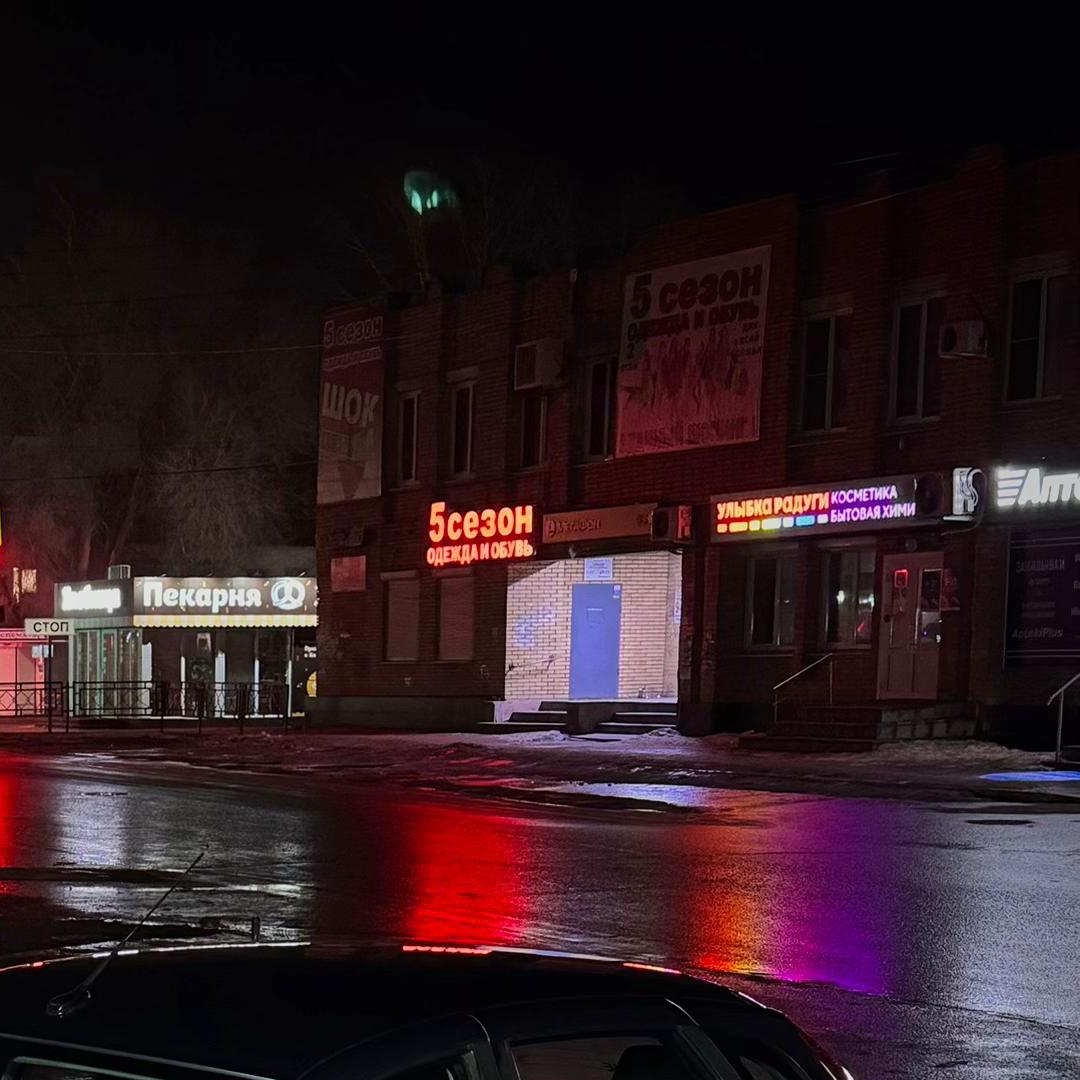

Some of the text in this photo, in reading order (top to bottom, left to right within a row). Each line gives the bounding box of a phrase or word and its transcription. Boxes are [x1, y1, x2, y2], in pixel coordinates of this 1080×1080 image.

[630, 264, 763, 319] 5 сезон
[322, 382, 381, 428] ШОК
[831, 485, 898, 504] КОСМЕТИКА
[1018, 468, 1080, 505] Апт
[717, 492, 830, 520] УЛЫБКА РАДУГИ
[830, 503, 916, 523] БЫТОВАЯ ХИМИ
[428, 501, 533, 542] 5 сезон
[426, 540, 534, 567] ОДЕЖДА И ОБУВЬ
[143, 582, 262, 613] Пекарня
[33, 621, 69, 633] СТОП
